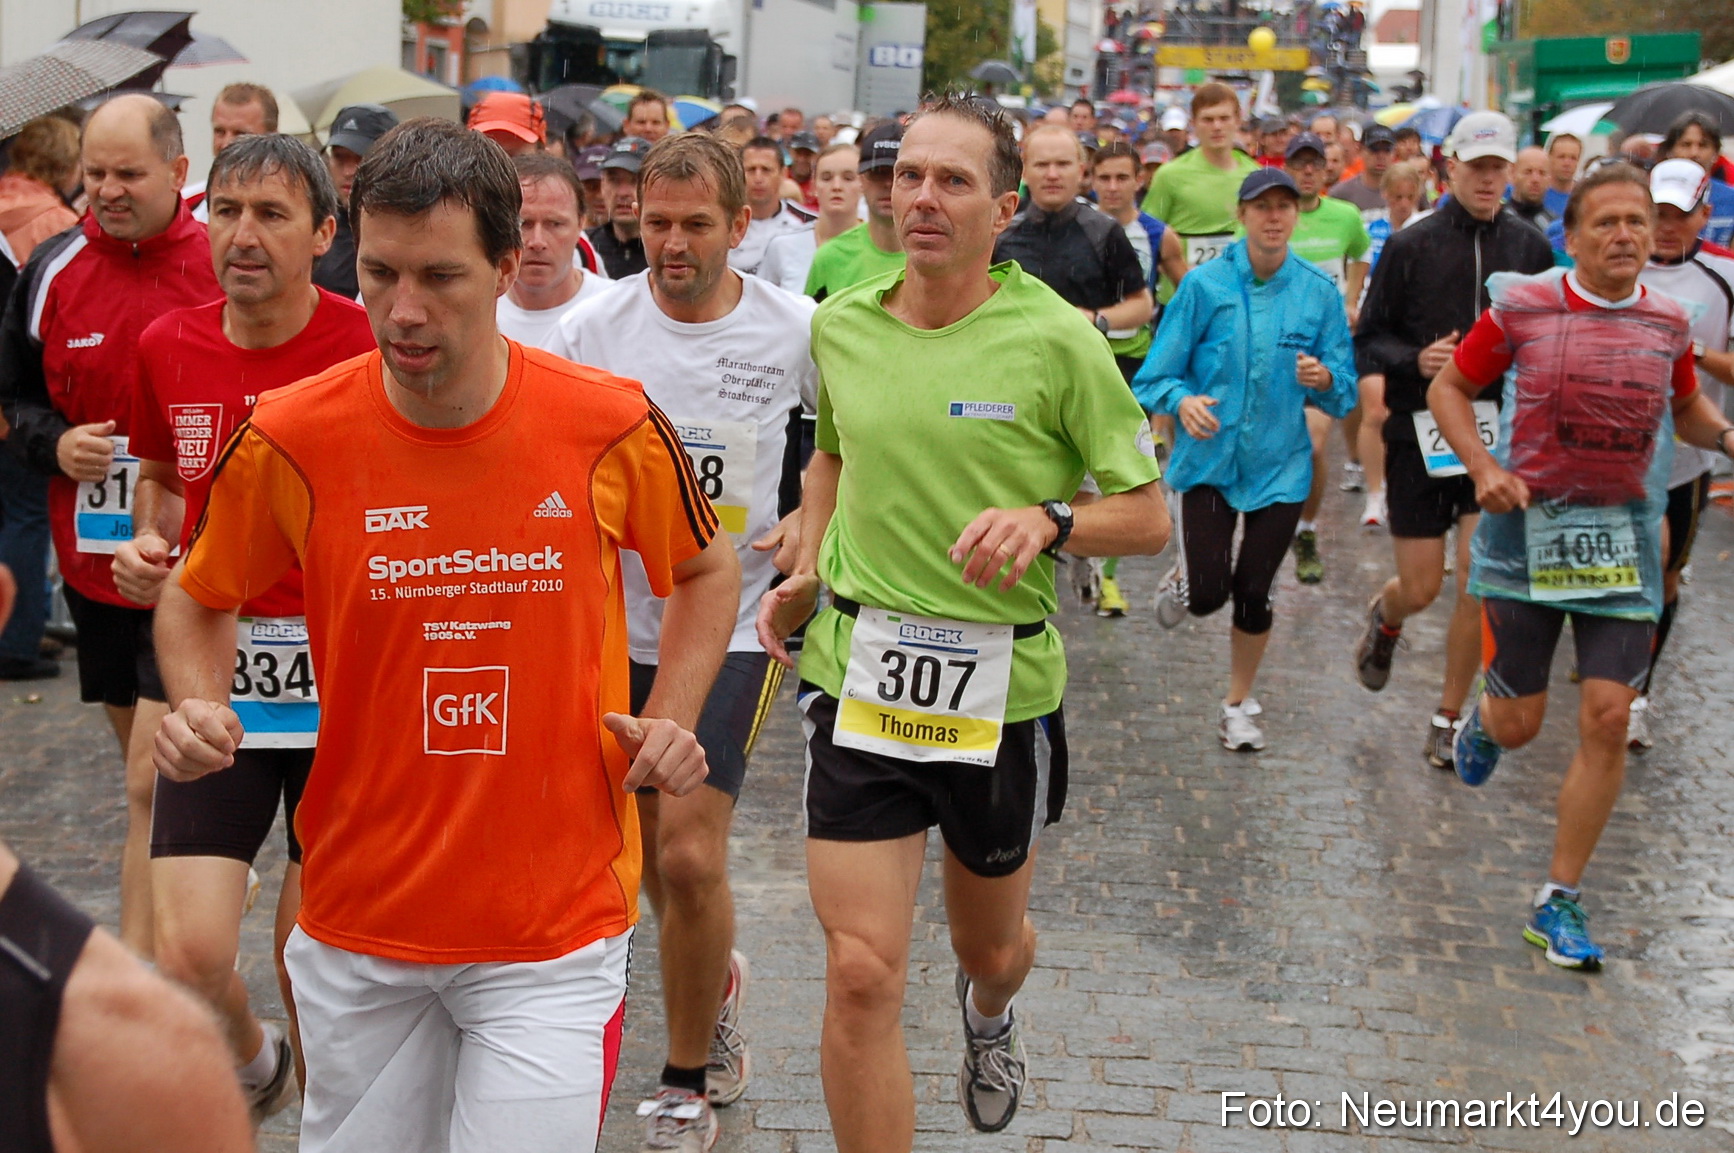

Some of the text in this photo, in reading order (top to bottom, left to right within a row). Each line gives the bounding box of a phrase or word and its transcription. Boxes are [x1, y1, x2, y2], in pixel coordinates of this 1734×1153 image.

[716, 357, 785, 377] Marathonteam
[964, 402, 1014, 415] PFLEIDERER
[175, 414, 212, 427] IMMER
[177, 439, 210, 457] NEU
[365, 505, 430, 533] DAK
[533, 507, 573, 518] adidas
[368, 545, 563, 584] SportScheck
[369, 578, 564, 601] 15. Nürnberger Stadtlauf 2010
[251, 623, 310, 638] BOCK
[423, 620, 511, 632] TSV Katzwang
[423, 631, 453, 641] 1905
[899, 623, 963, 645] BOCK
[876, 649, 977, 711] 307
[433, 692, 499, 727] GfK
[878, 712, 960, 744] Thomas
